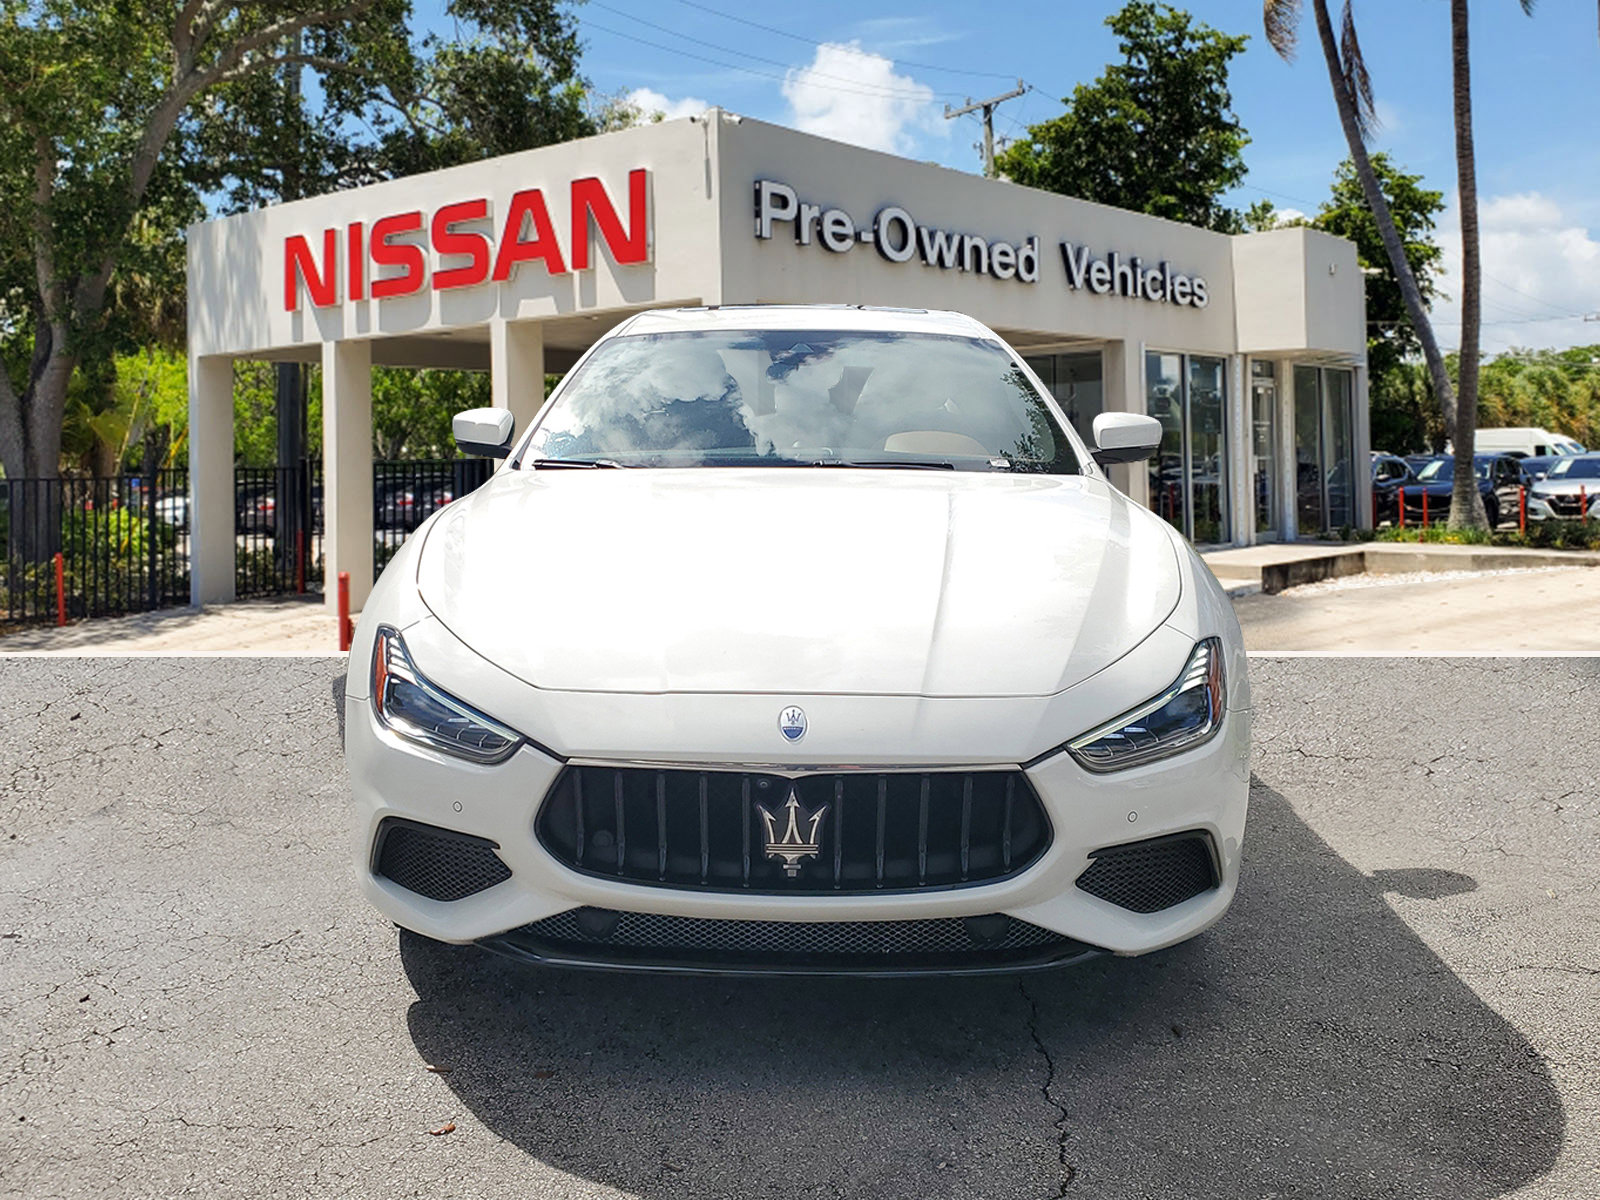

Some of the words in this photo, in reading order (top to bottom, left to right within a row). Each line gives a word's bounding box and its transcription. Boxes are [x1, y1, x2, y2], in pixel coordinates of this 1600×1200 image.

[285, 168, 648, 312] NISSAN
[755, 180, 1040, 283] Pre-Owned
[1061, 242, 1209, 308] Vehicles
